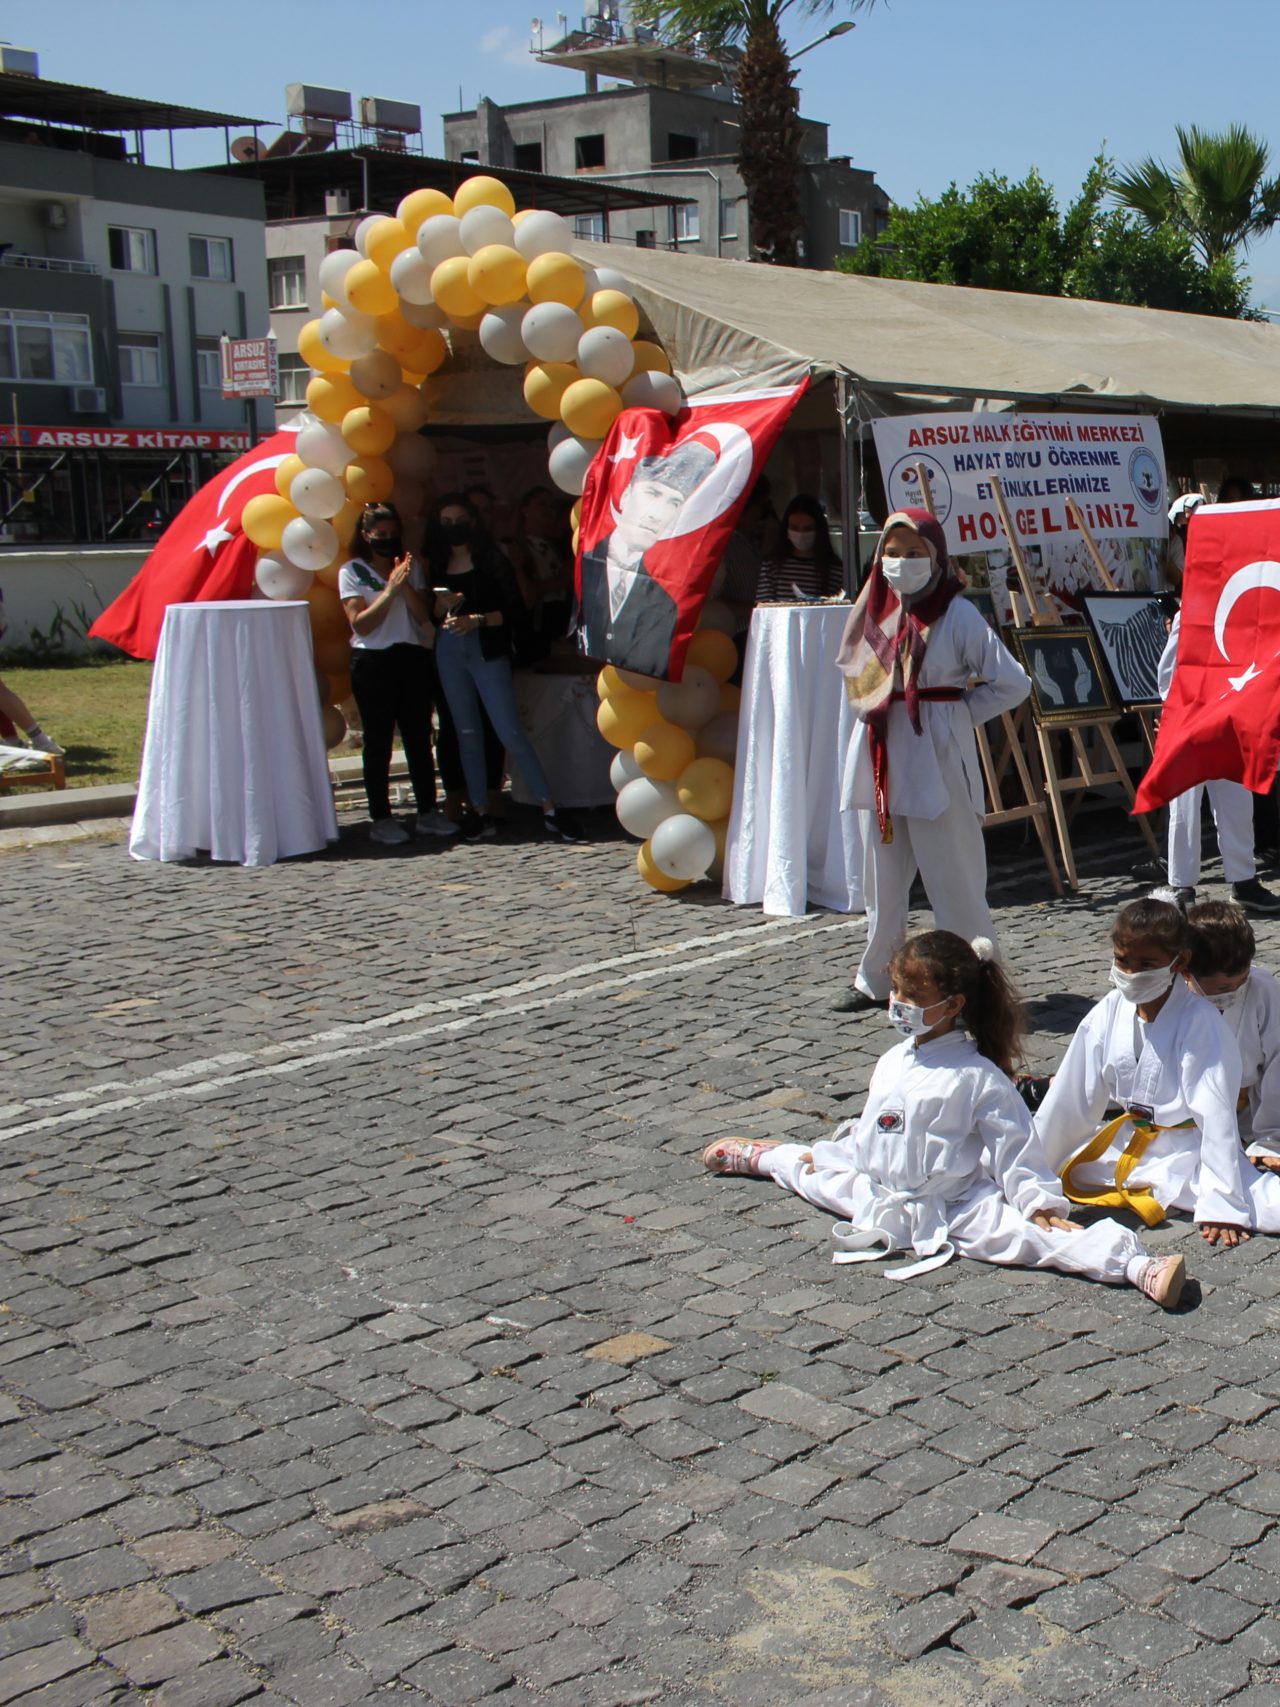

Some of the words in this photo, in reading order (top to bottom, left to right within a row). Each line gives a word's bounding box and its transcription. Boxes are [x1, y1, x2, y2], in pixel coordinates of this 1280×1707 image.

[234, 342, 266, 358] ARSUZ
[37, 431, 129, 447] ARSUZ
[137, 431, 212, 448] KİTAP
[908, 425, 970, 448] ARSUZ
[973, 424, 1012, 443] HALK
[1077, 422, 1145, 443] MERKEZİ
[953, 452, 1001, 472] HAYAT
[1004, 451, 1041, 469] BOYU
[1048, 446, 1121, 467] ÖĞRENME
